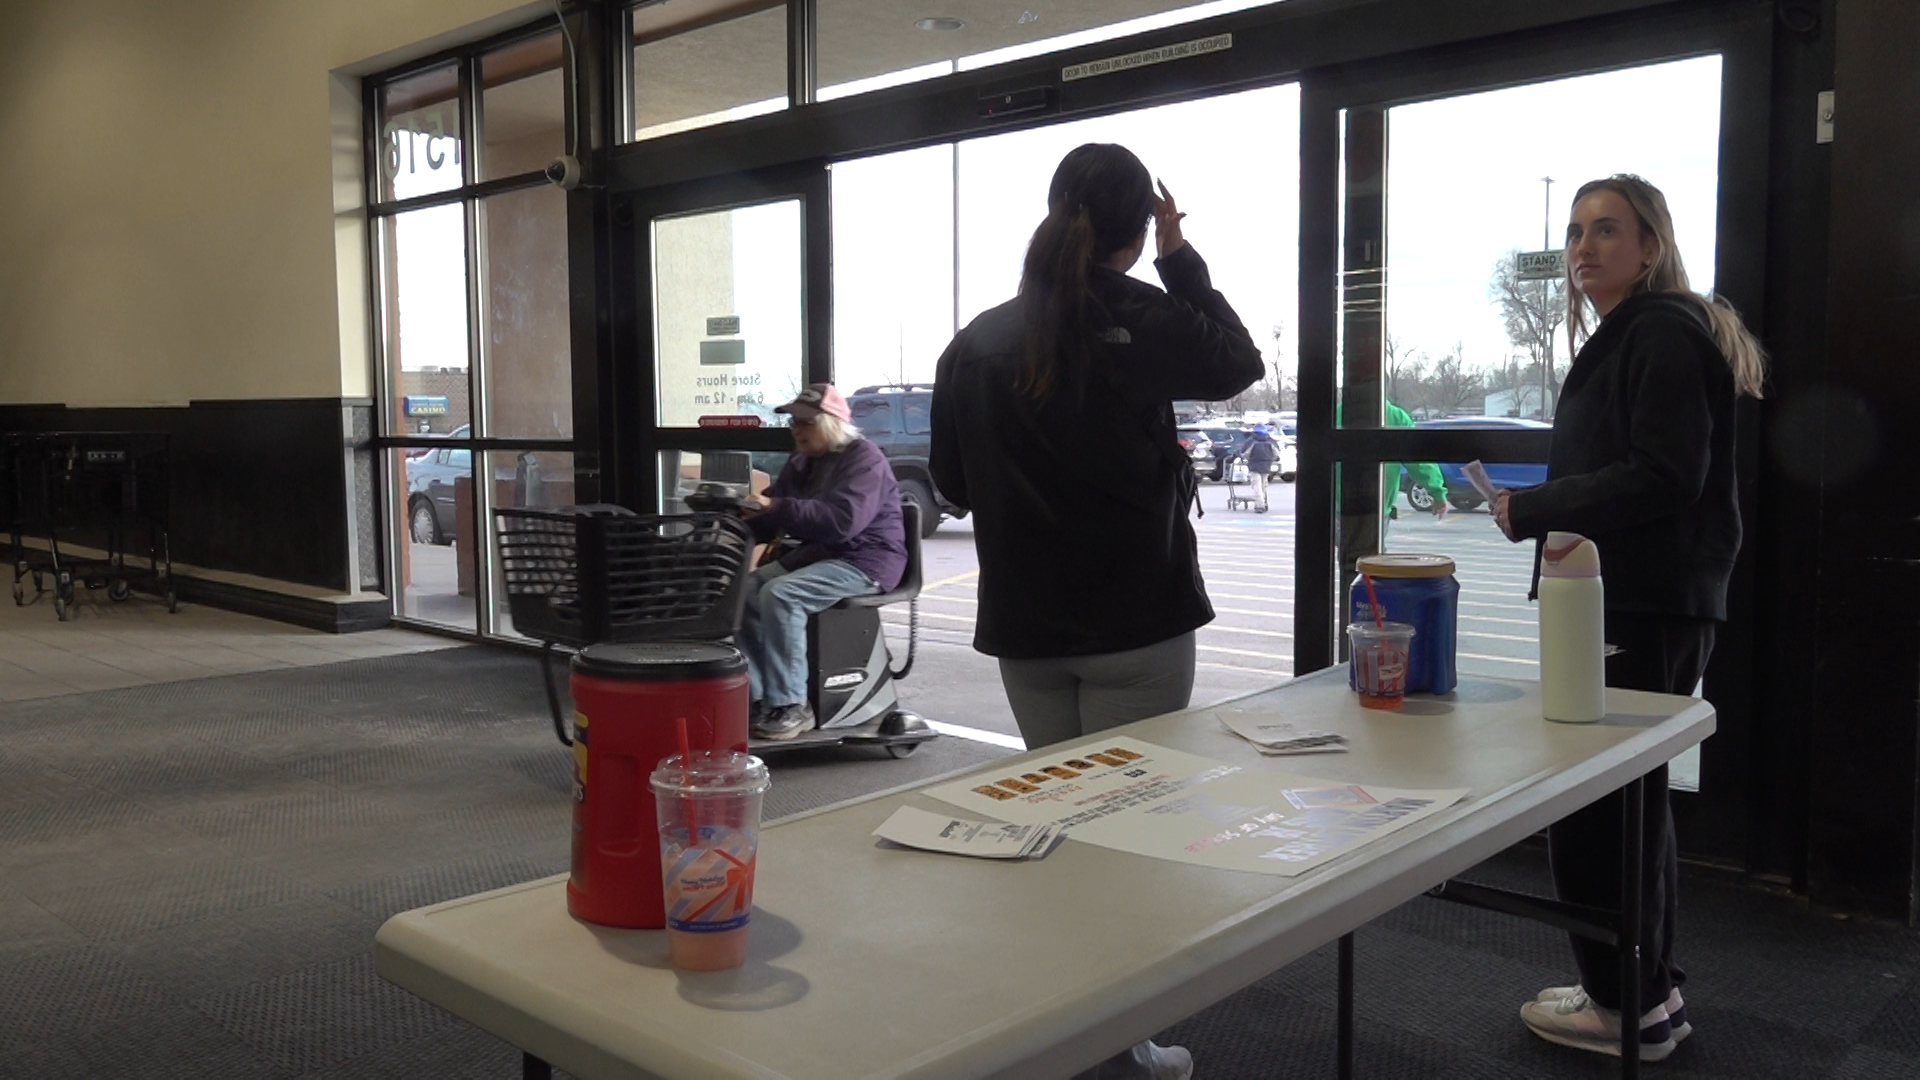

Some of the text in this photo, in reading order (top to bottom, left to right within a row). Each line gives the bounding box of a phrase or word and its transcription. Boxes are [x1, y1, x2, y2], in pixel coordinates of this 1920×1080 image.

[1064, 36, 1230, 79] DOOR TO REMAIN UNLOCKED WHEN BUILDING IS OCCUPIED
[1522, 254, 1557, 267] STAND
